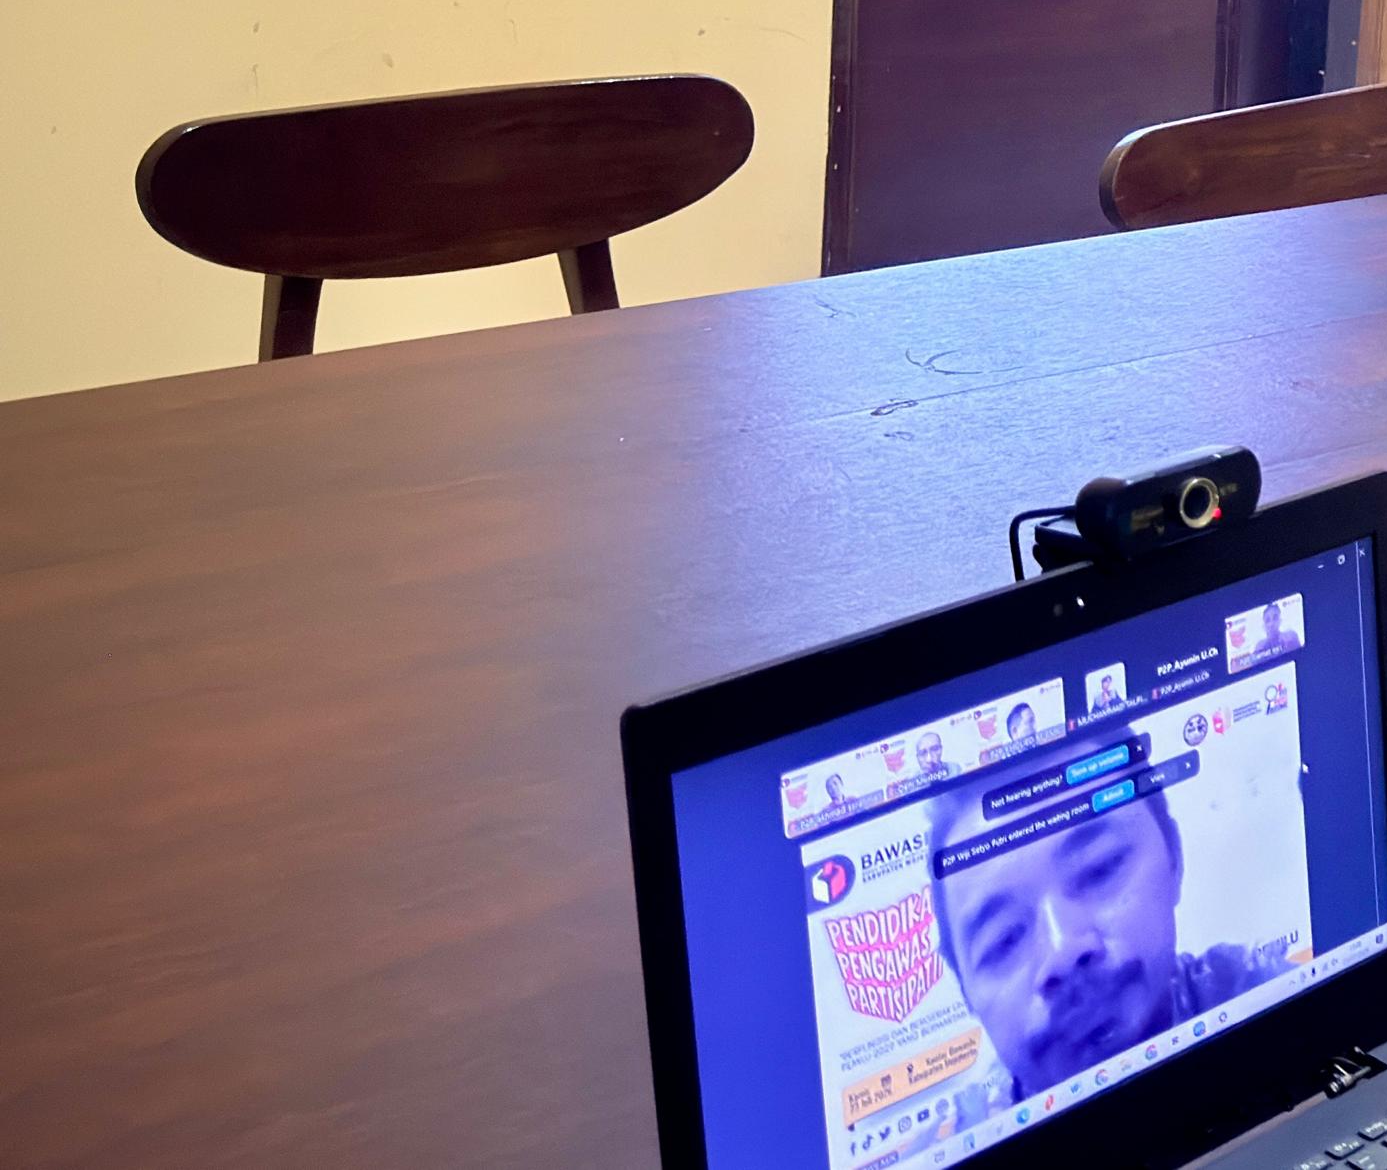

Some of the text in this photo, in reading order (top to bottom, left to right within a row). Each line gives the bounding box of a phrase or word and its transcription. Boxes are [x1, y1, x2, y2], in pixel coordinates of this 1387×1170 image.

[991, 796, 1005, 810] Not
[1005, 786, 1032, 808] hearing
[1008, 823, 1034, 841] entered
[1071, 802, 1090, 816] room
[861, 832, 928, 871] BAWAS
[826, 885, 934, 949] PENDIDIKA
[846, 953, 943, 1023] PARTISIPATI
